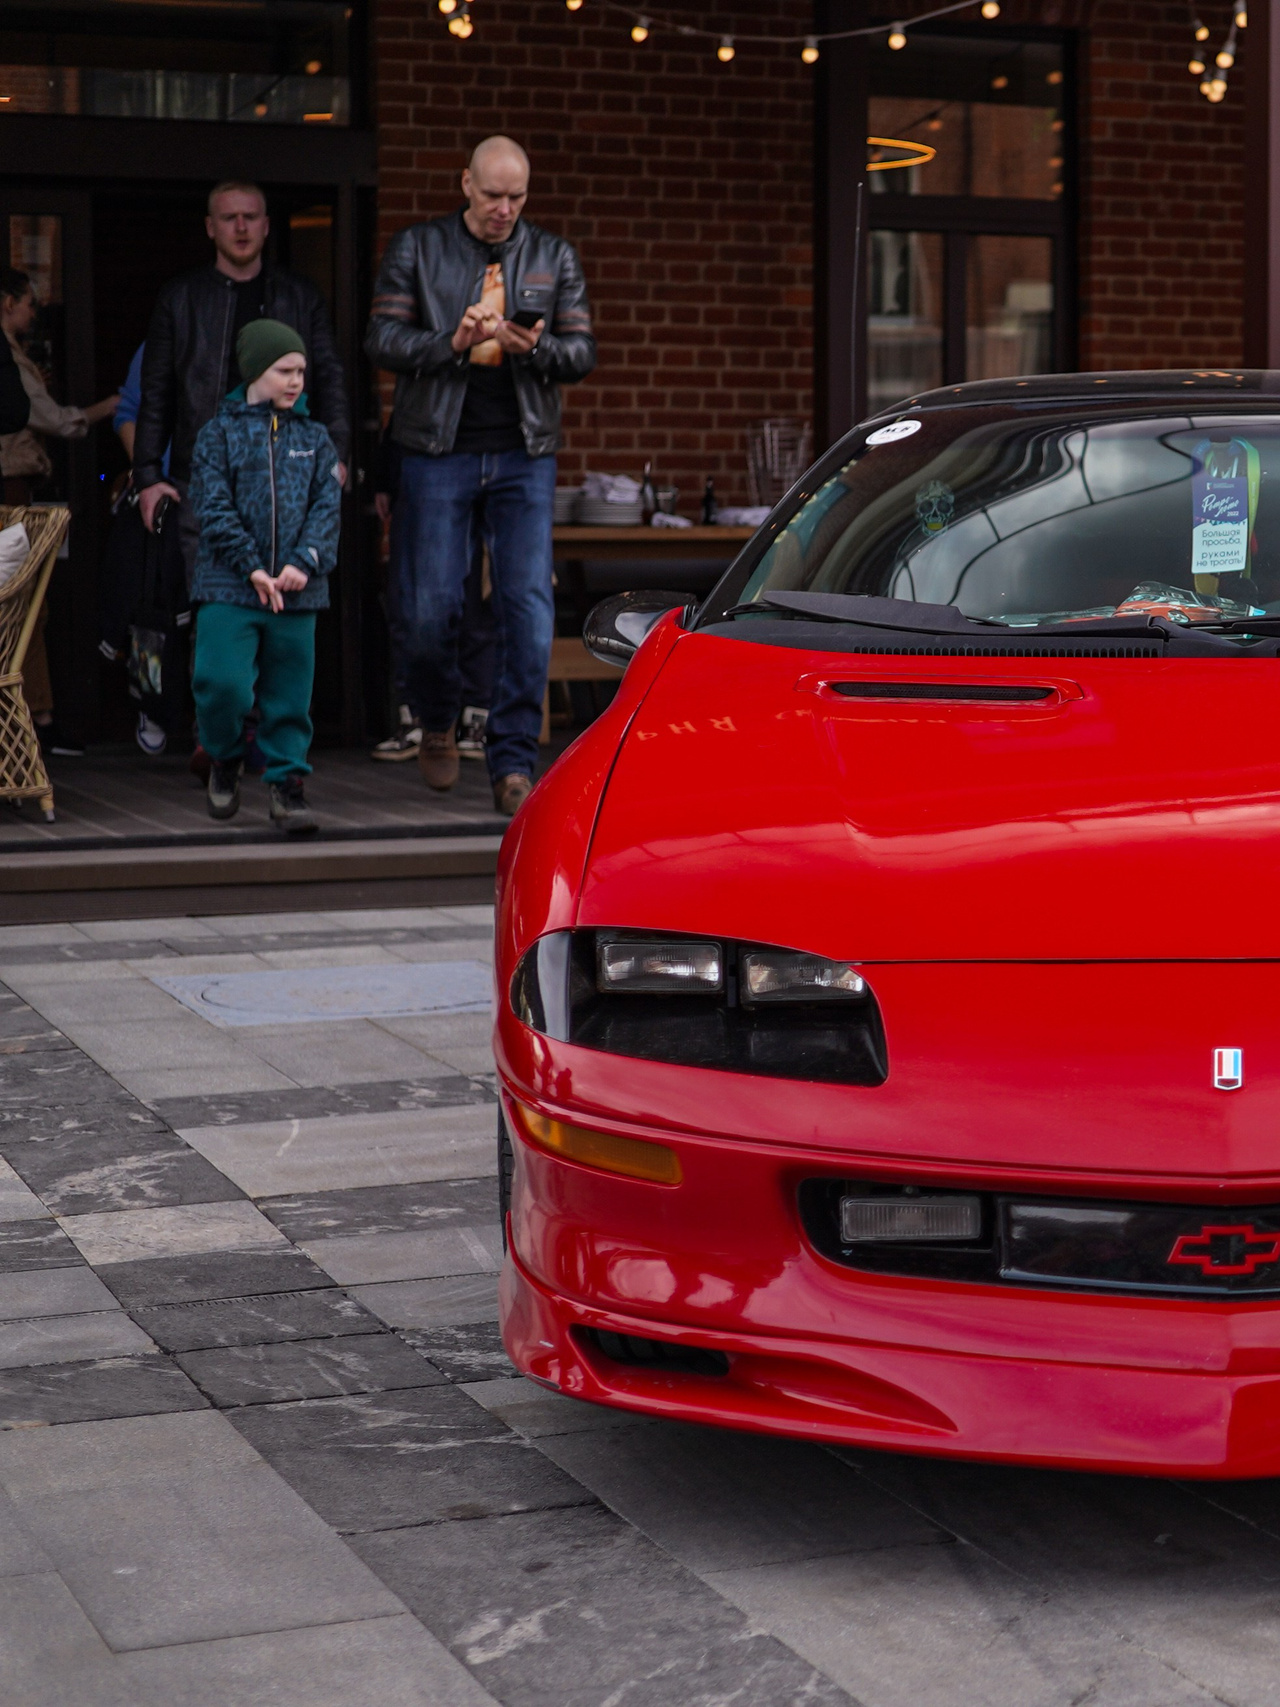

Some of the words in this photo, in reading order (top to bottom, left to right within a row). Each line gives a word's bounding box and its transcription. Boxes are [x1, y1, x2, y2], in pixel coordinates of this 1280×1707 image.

[1202, 529, 1241, 538] Большая
[1201, 550, 1240, 560] руками
[1210, 556, 1244, 567] трогать!
